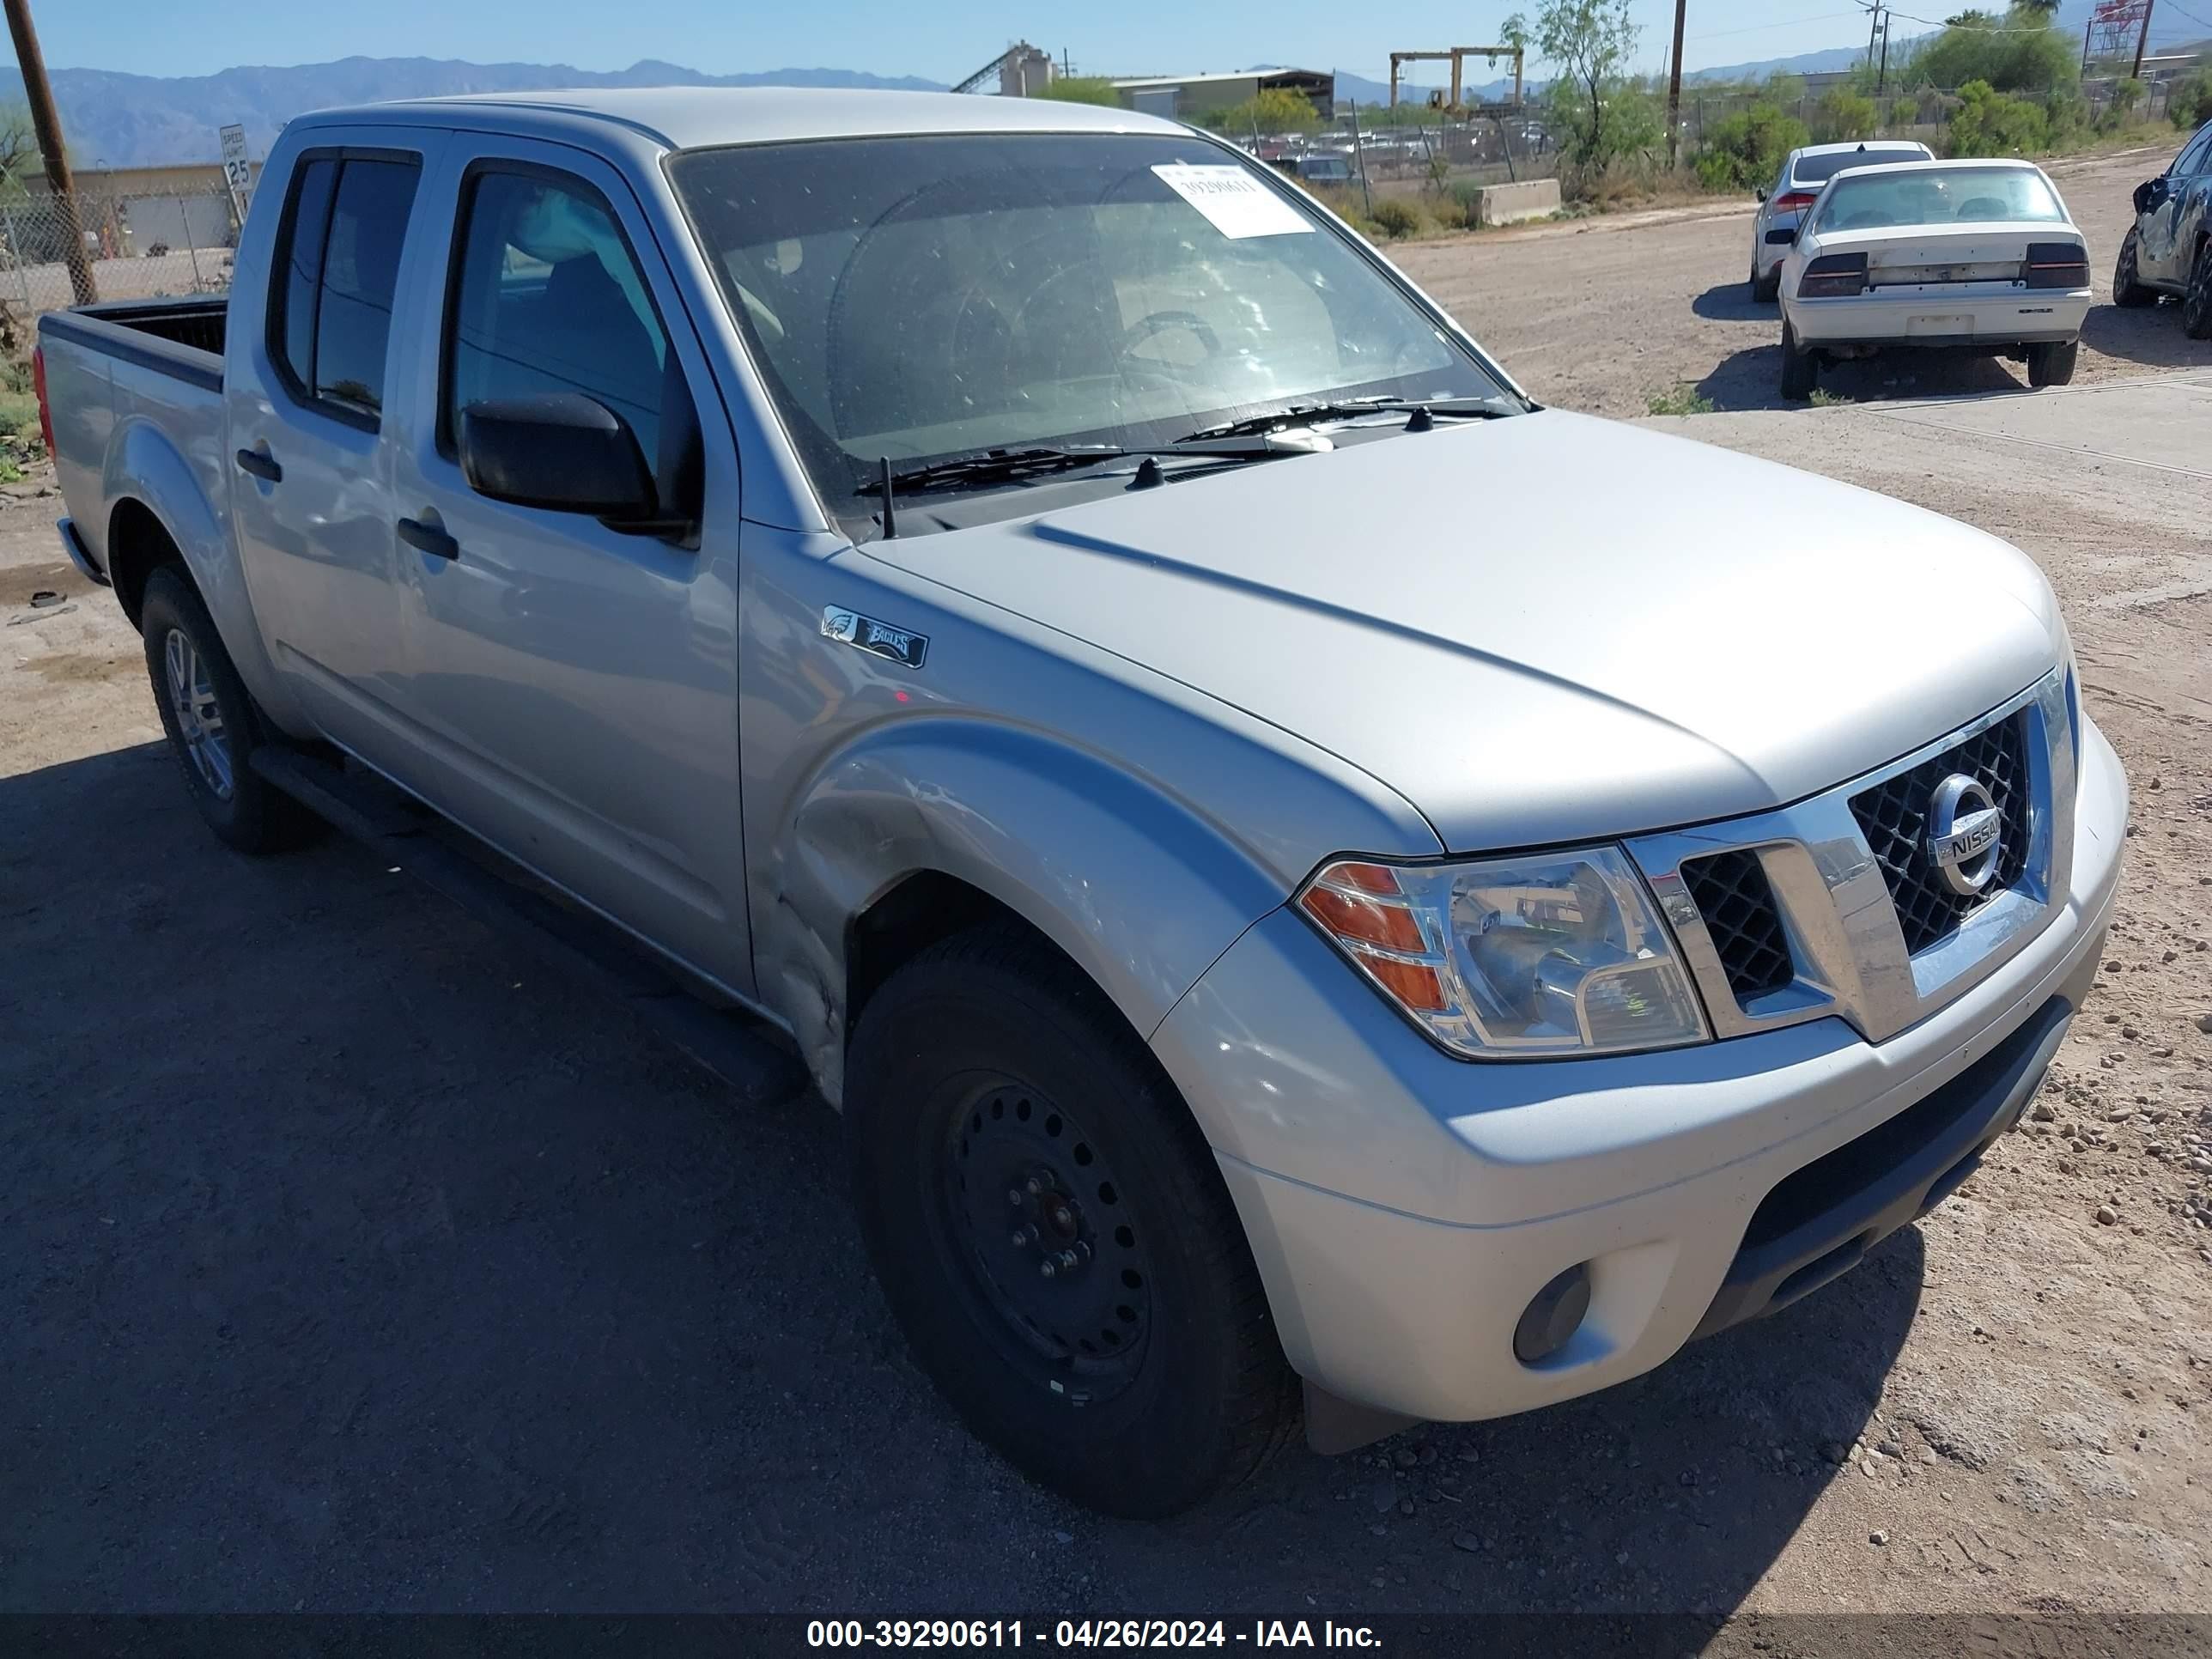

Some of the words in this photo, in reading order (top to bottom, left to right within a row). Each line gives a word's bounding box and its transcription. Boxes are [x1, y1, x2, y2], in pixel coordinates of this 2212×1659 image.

[223, 132, 243, 144] SPEED
[228, 160, 249, 185] 25
[869, 624, 908, 657] EAGLES
